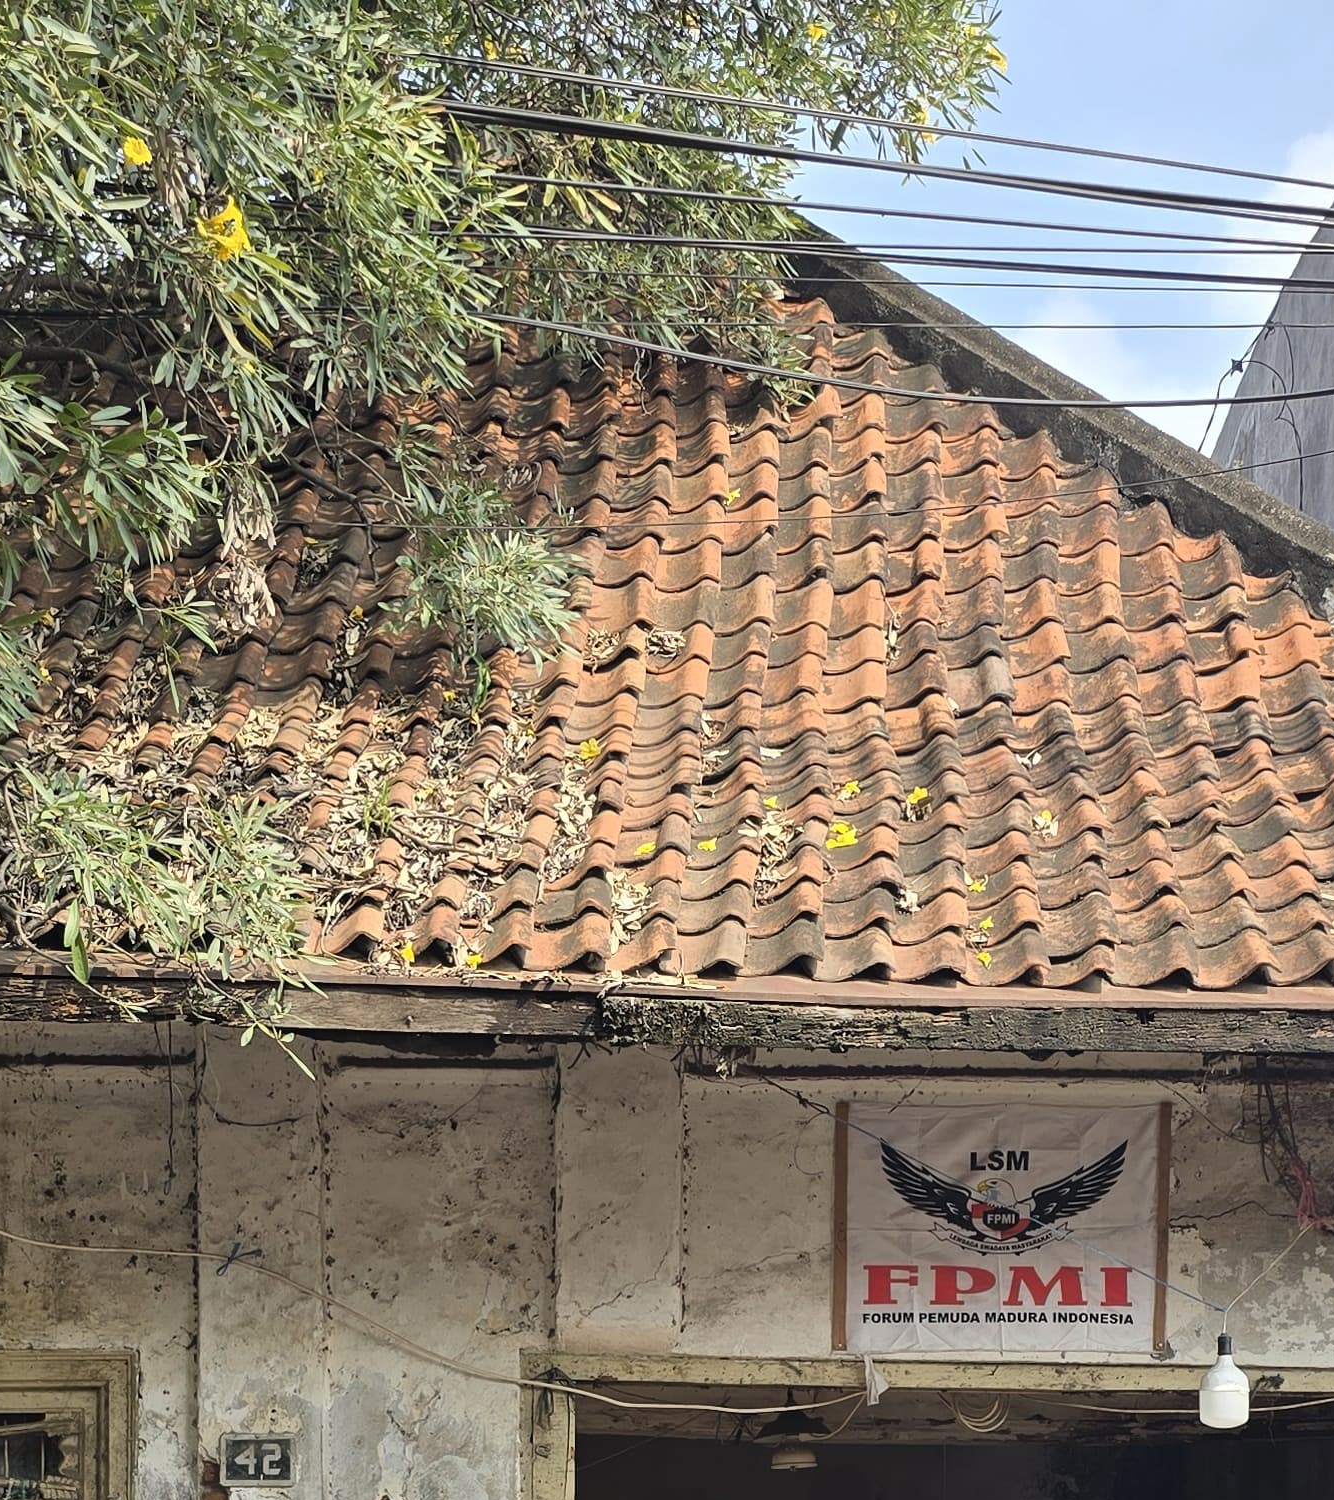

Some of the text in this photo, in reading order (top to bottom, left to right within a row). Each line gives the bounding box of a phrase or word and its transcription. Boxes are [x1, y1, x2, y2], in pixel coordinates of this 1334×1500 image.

[970, 1150, 1029, 1172] LSM
[987, 1213, 1016, 1225] FPMI
[862, 1264, 1134, 1307] FPMI
[862, 1311, 1134, 1326] FORUM PEMUDA MADURA INDONESIA
[233, 1442, 283, 1476] 42
